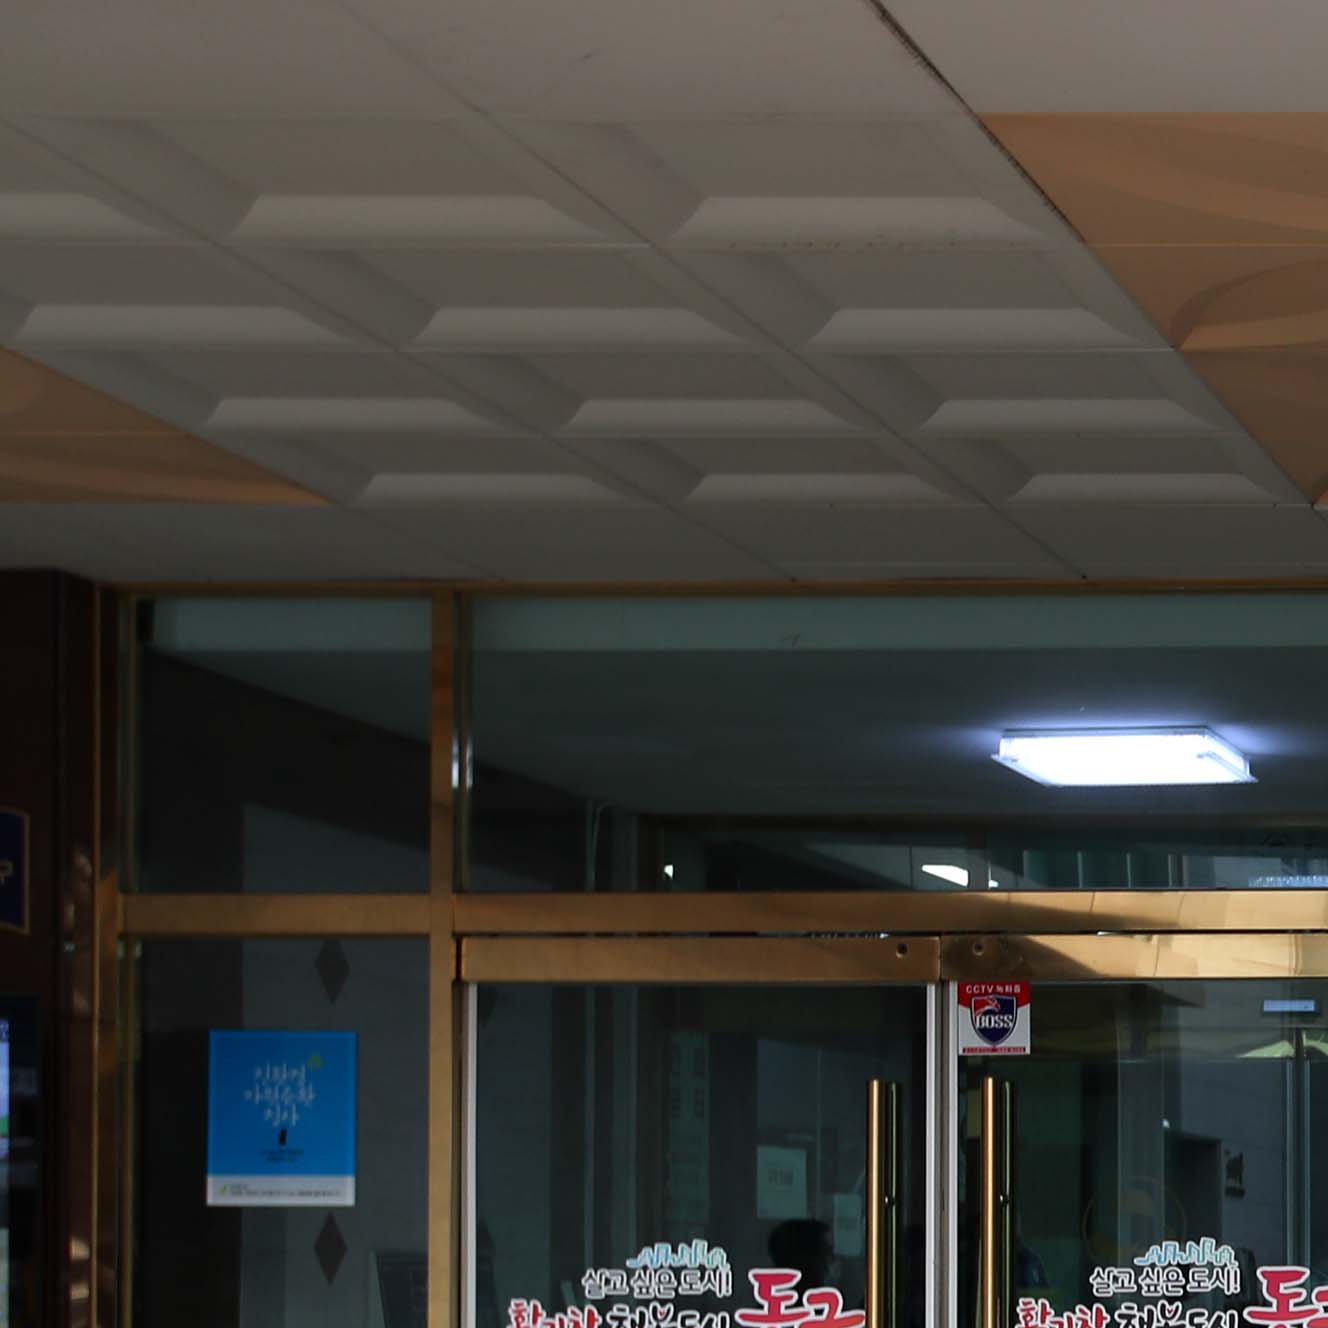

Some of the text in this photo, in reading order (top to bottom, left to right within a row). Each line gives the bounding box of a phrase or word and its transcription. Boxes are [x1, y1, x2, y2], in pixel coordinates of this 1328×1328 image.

[966, 985, 993, 993] CCTV
[976, 1015, 1012, 1028] BOSS
[582, 1268, 732, 1299] 살고 싶은 도시!
[1091, 1265, 1240, 1297] 살고 싶은 도시!
